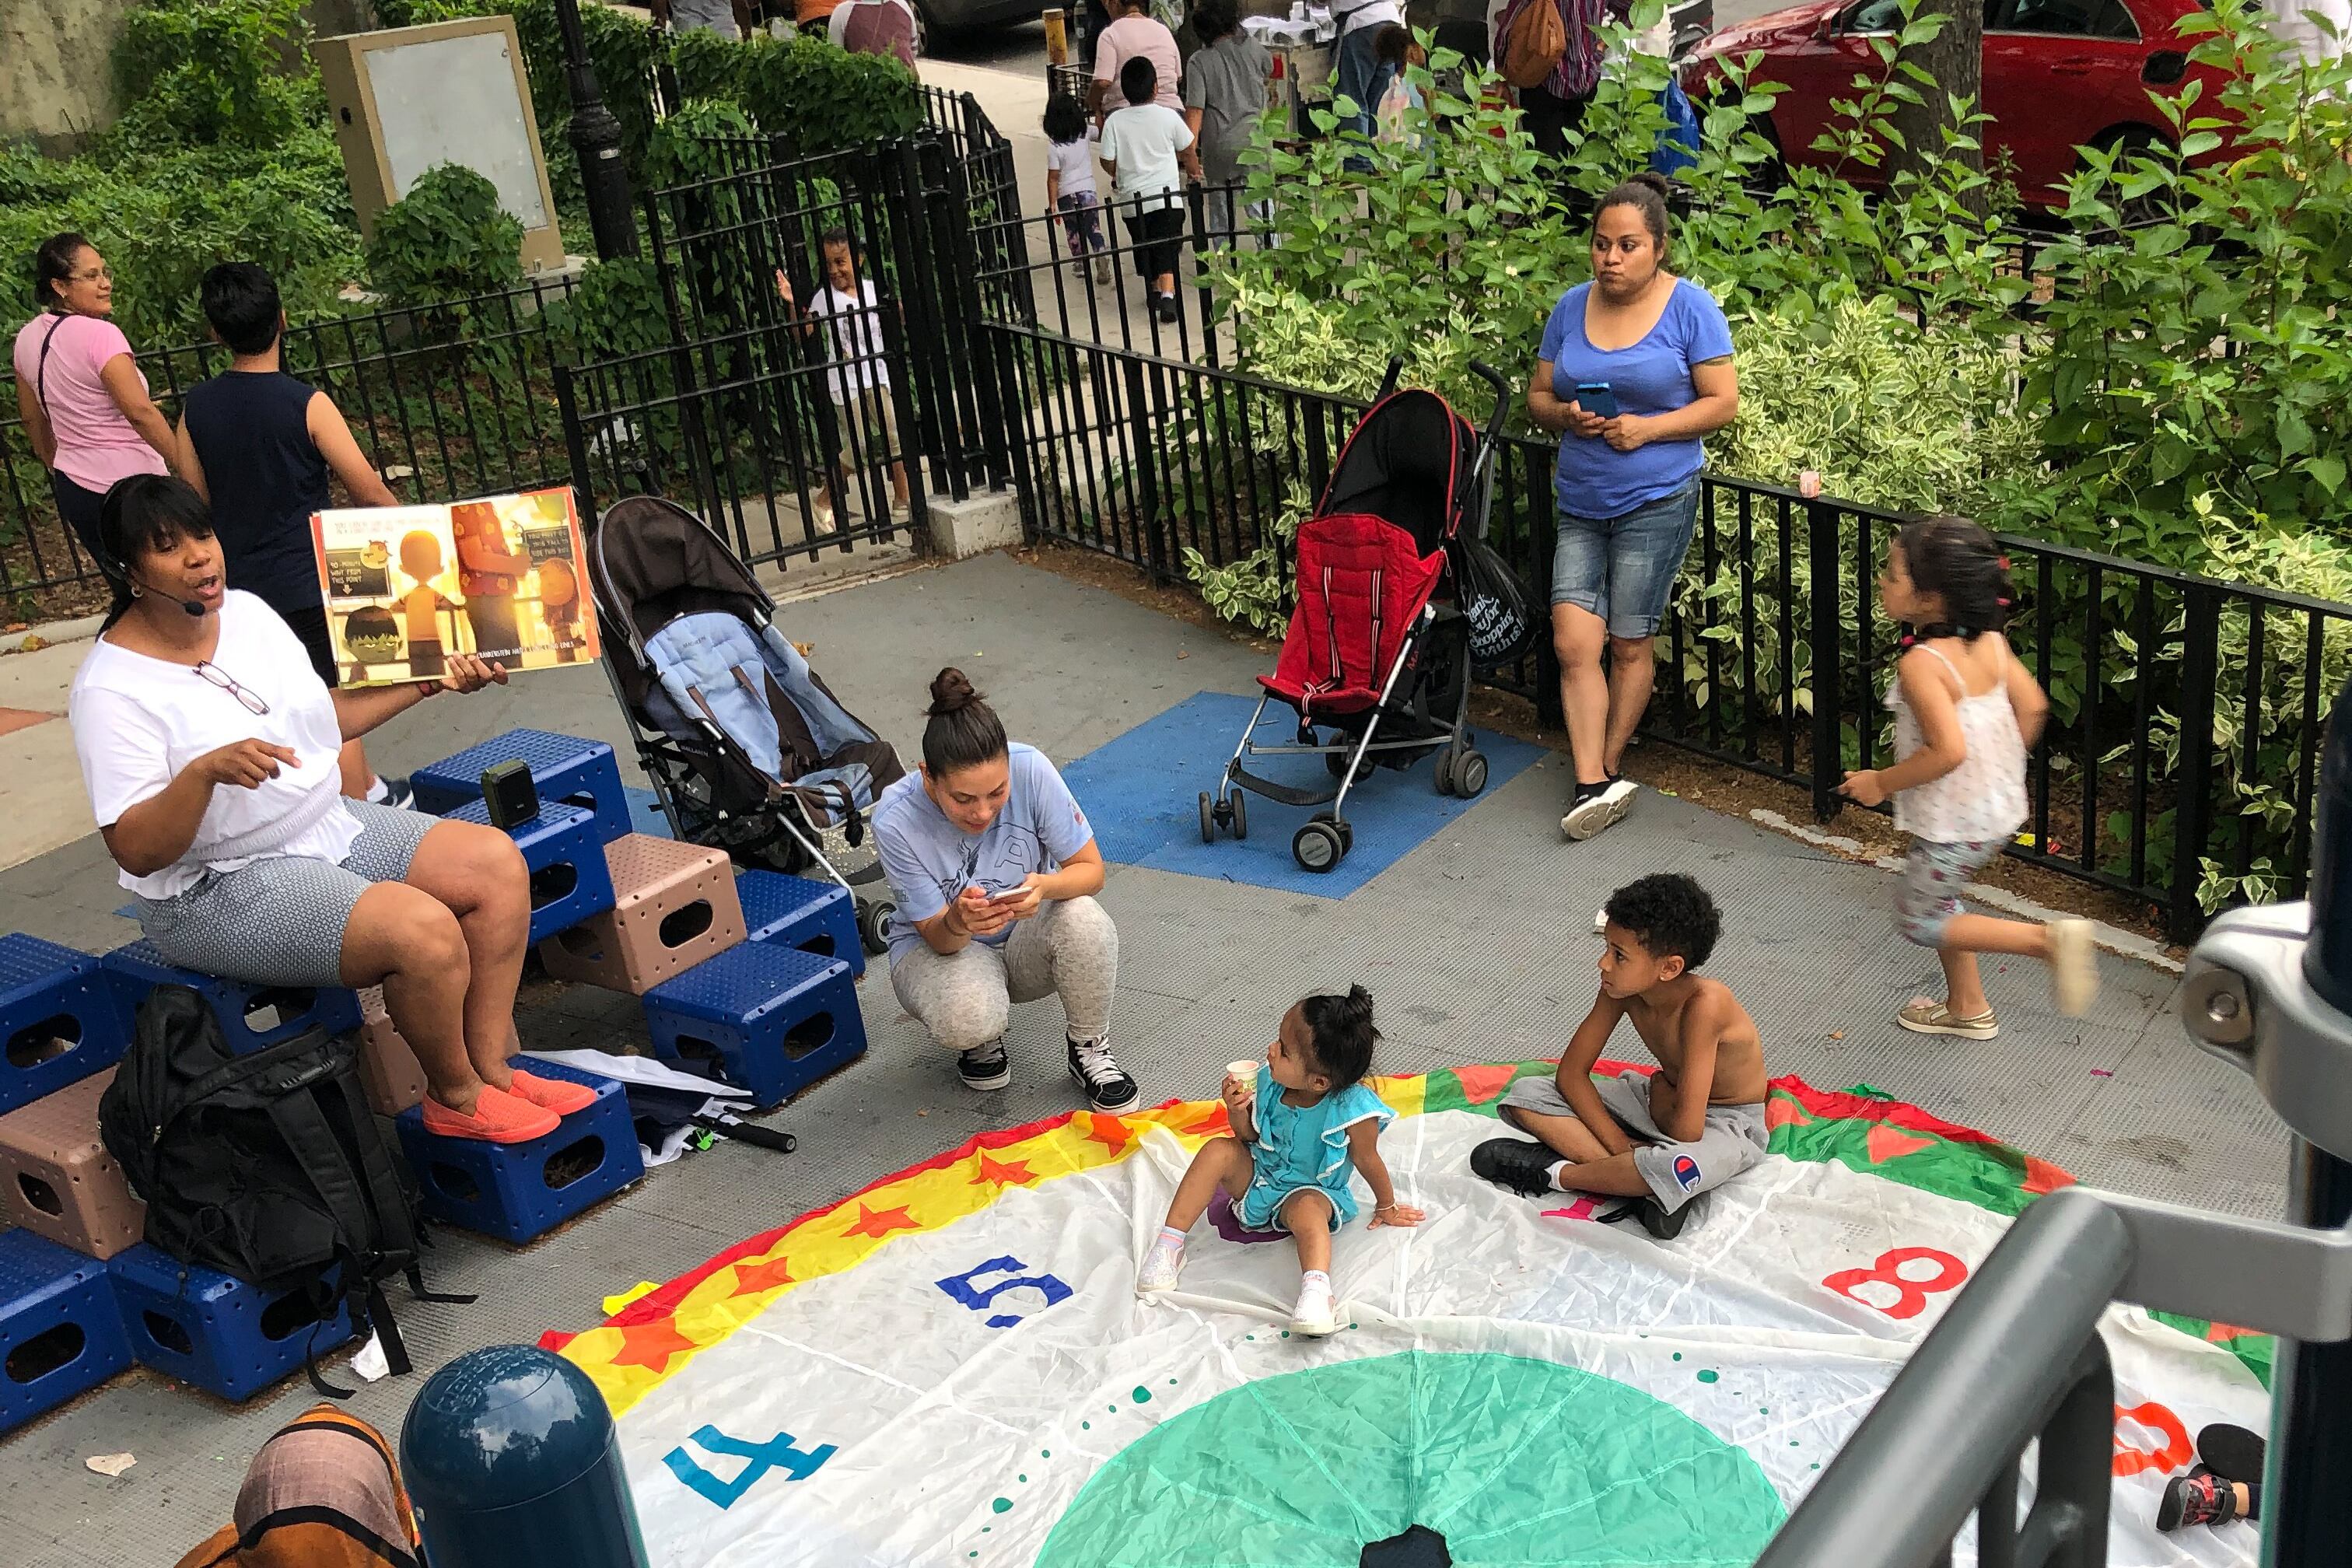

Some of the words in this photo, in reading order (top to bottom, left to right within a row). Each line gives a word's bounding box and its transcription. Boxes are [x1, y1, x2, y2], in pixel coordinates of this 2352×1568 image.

[934, 1255, 1073, 1328] 5
[1822, 1247, 1969, 1320] 8
[661, 1424, 840, 1510] 4
